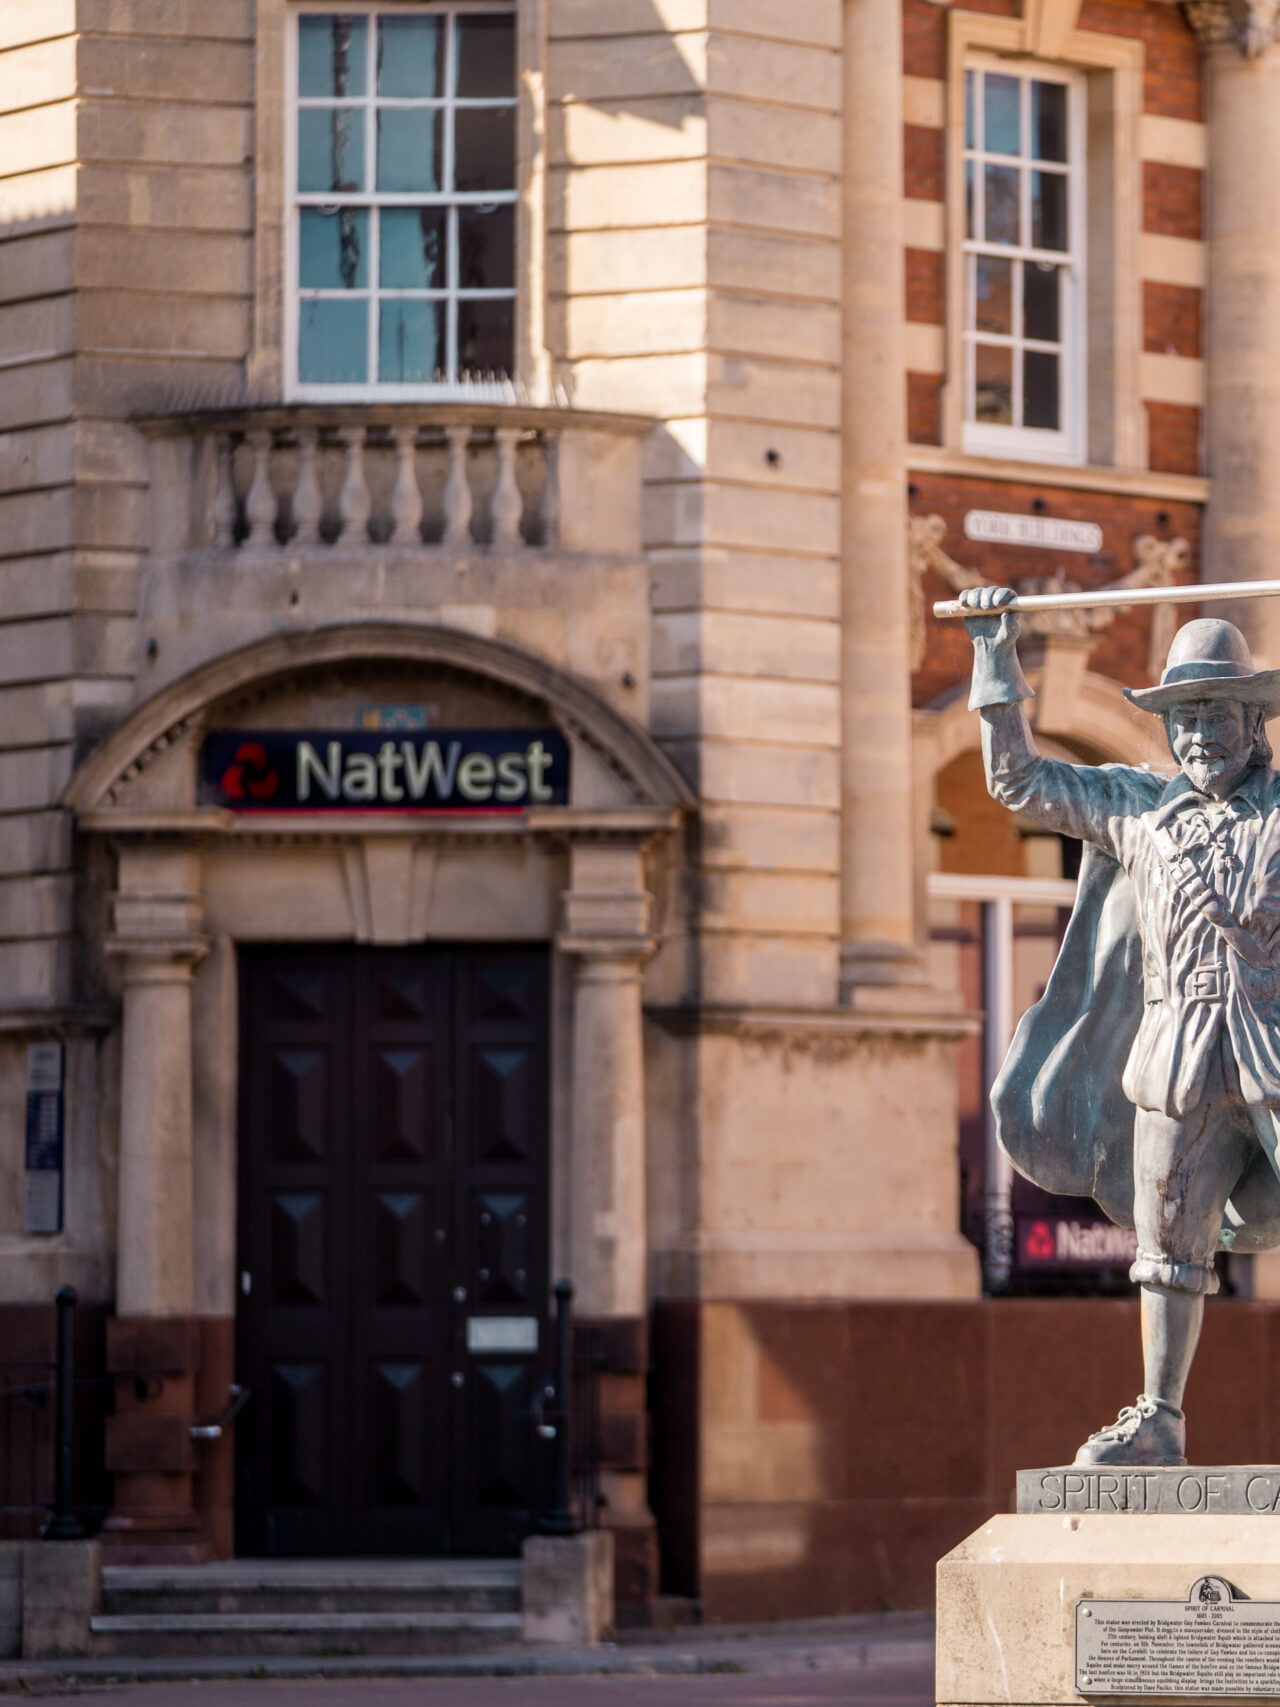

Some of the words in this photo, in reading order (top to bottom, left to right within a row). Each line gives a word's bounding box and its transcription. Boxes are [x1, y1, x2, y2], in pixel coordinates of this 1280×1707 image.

[296, 740, 554, 802] NatWest
[1039, 1474, 1165, 1511] SPIRIT
[1176, 1474, 1226, 1511] OF
